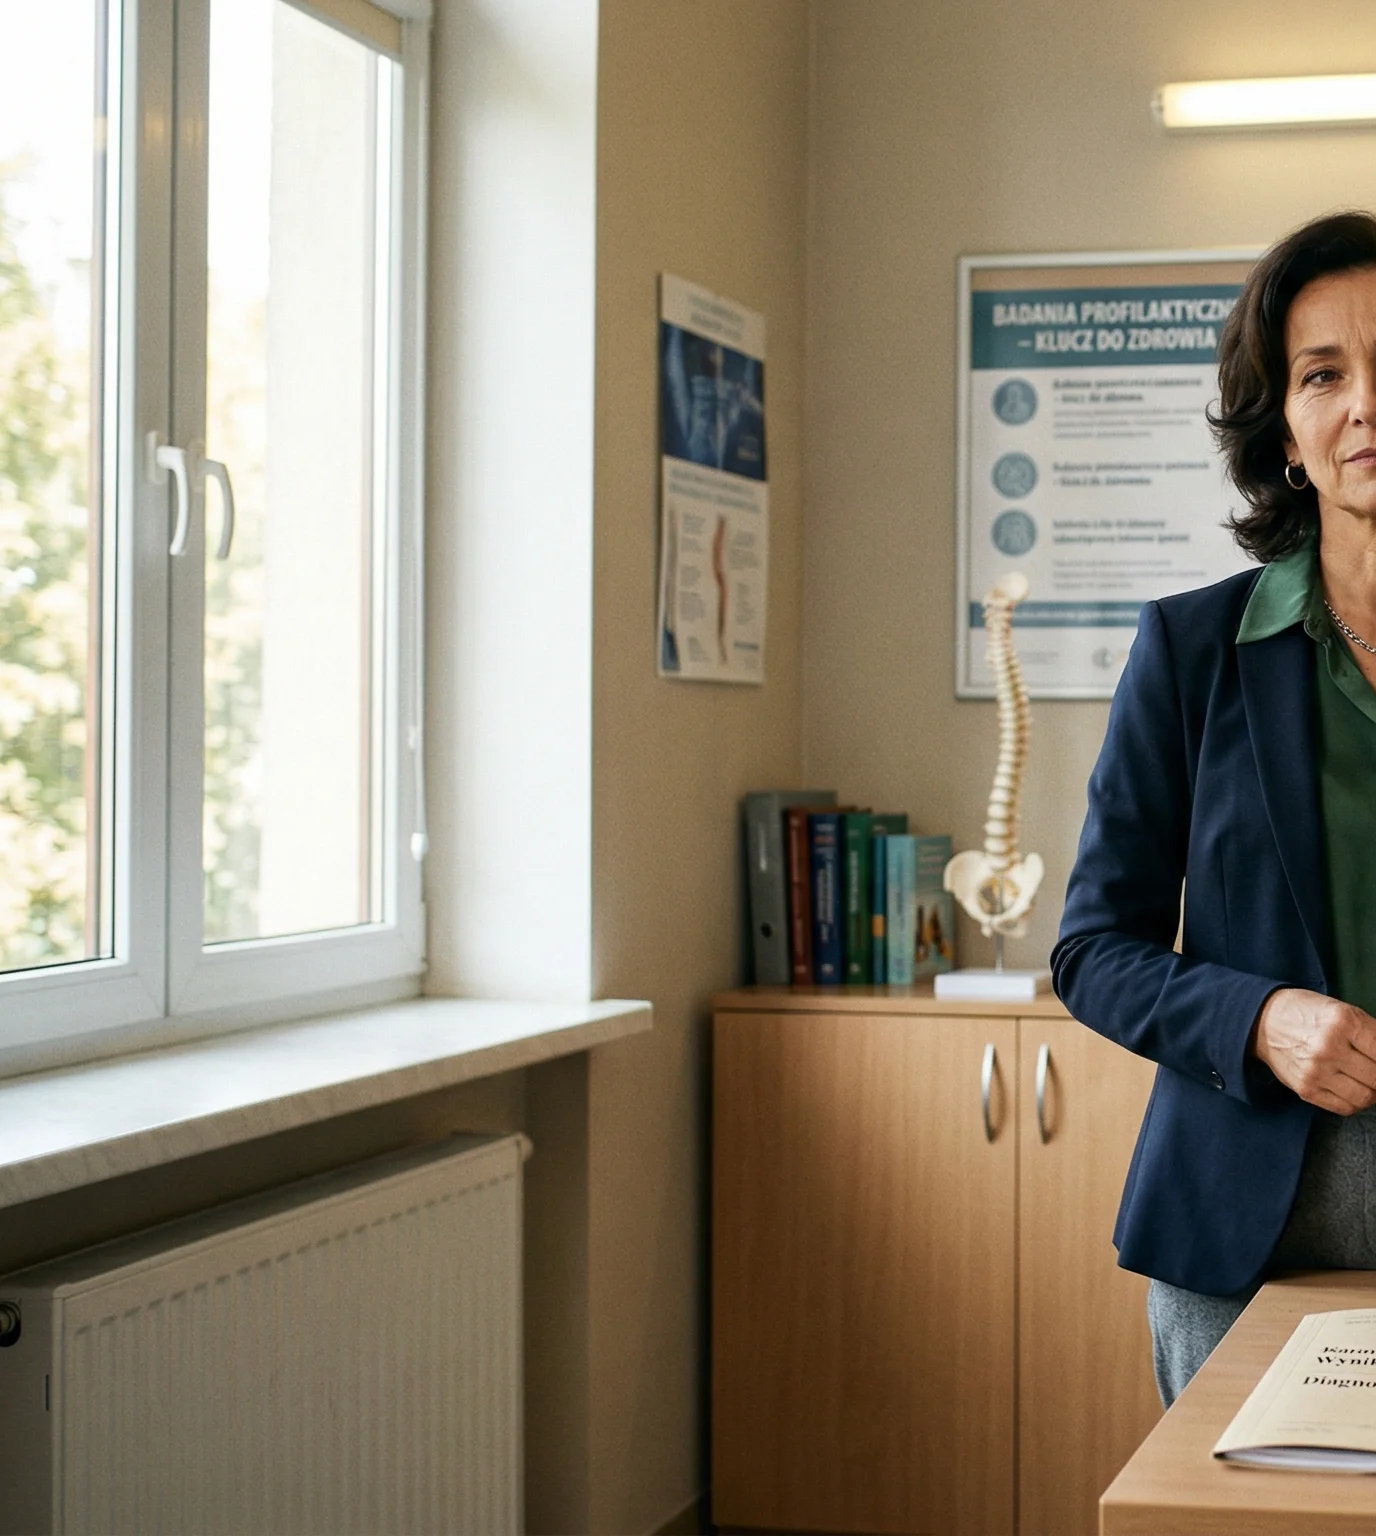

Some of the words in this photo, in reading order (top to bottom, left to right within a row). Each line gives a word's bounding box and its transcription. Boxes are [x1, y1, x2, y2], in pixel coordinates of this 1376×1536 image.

[992, 302, 1078, 327] BADANIA
[1081, 298, 1238, 324] PROFILAKTYCZN
[1035, 330, 1094, 352] KLUCZ
[1097, 328, 1125, 351] DO
[1127, 326, 1218, 351] ZDROWIA
